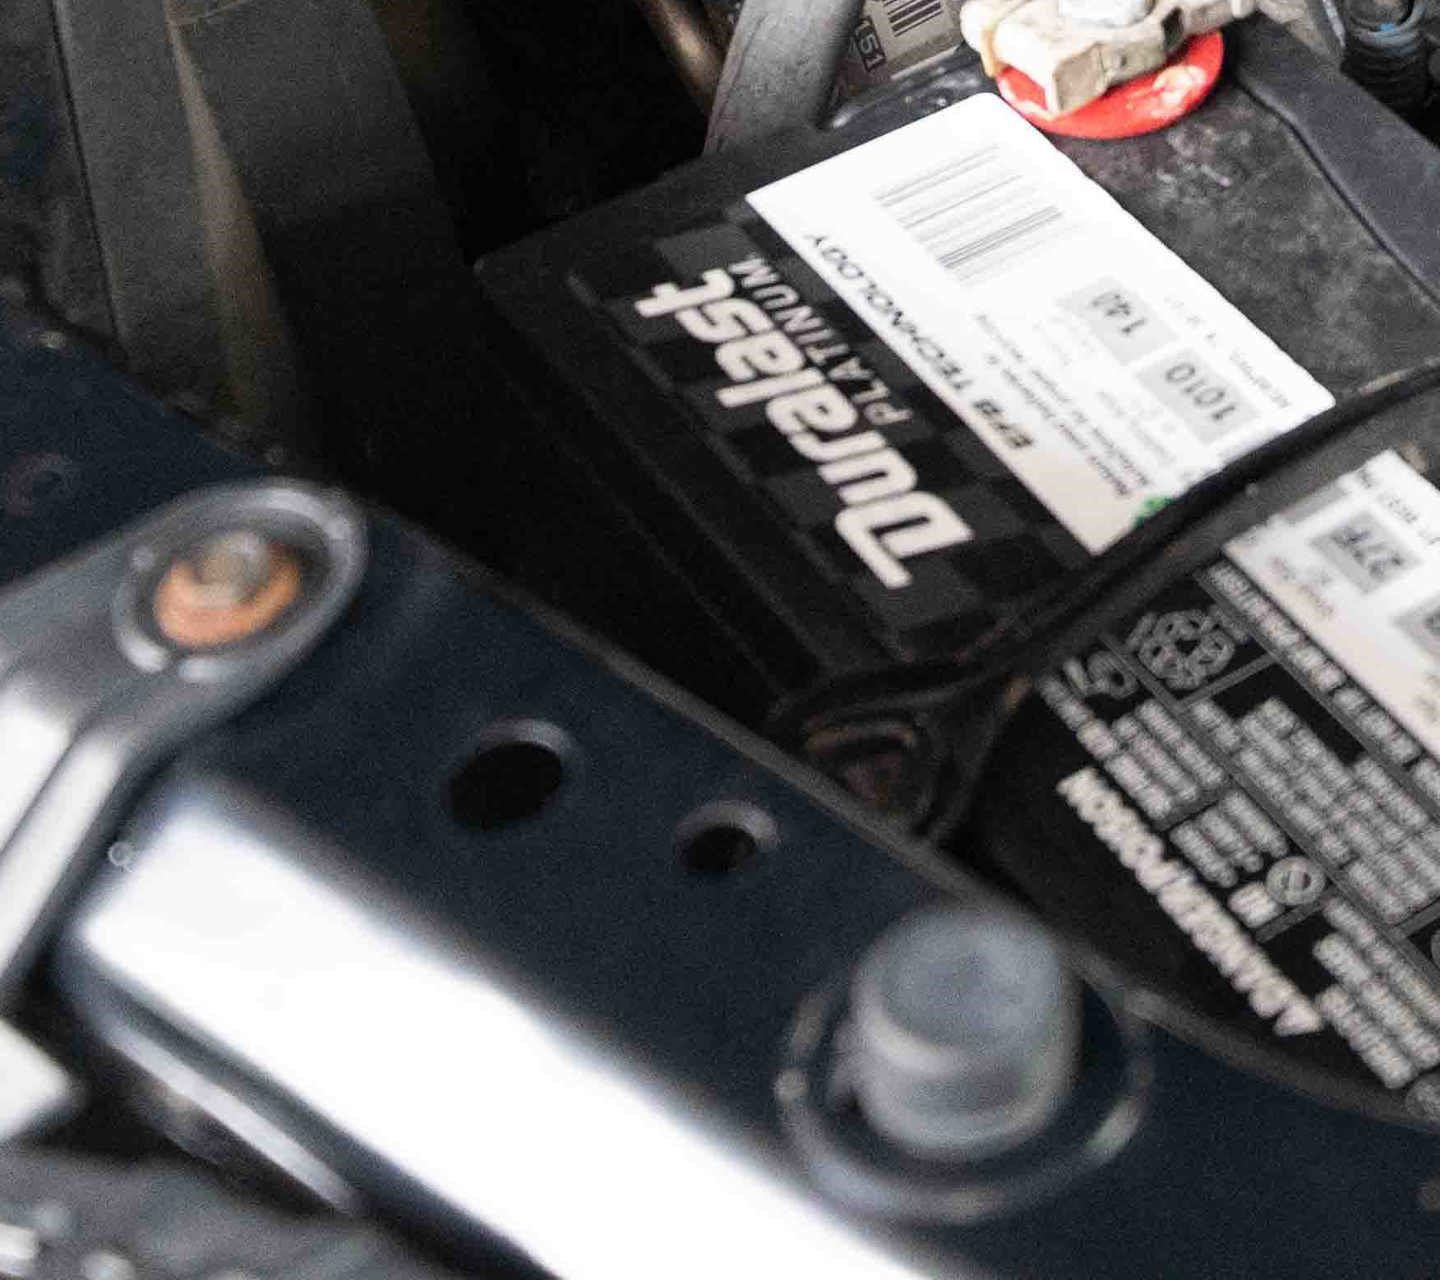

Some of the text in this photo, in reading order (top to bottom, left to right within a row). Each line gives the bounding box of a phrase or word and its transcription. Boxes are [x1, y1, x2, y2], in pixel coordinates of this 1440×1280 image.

[726, 255, 911, 427] PLATINUM
[801, 230, 973, 391] TECHNOLOGY
[1165, 359, 1238, 423] 1010
[634, 267, 973, 590] Duralast
